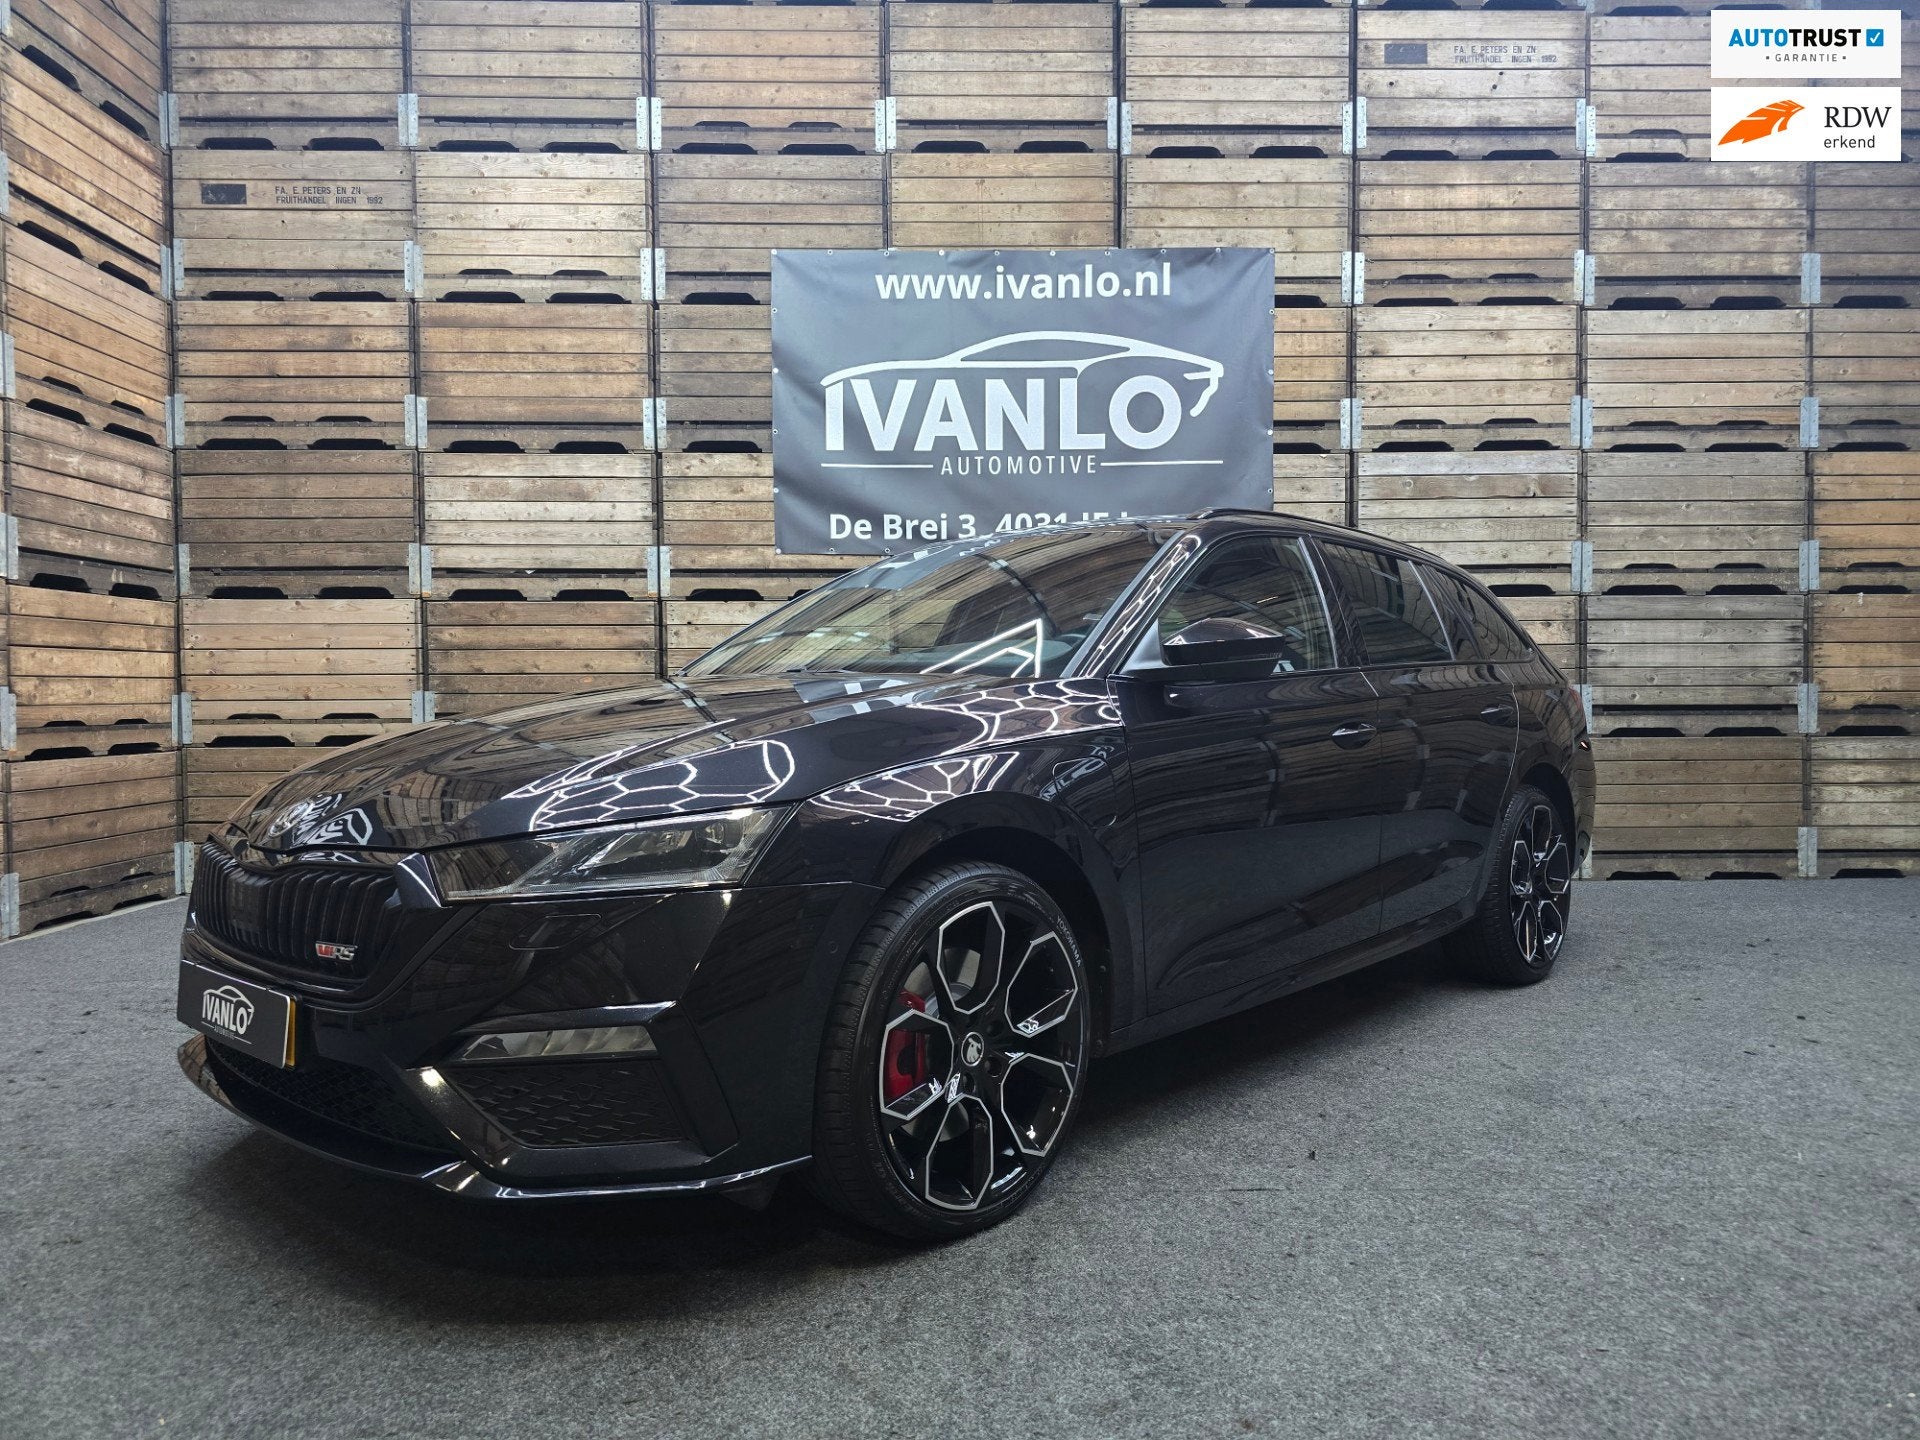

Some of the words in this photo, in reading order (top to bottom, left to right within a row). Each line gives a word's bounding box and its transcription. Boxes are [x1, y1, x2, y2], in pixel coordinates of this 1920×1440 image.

[1480, 45, 1508, 54] PETERS
[1512, 45, 1523, 54] EN
[1526, 45, 1537, 54] ZN
[1511, 55, 1532, 63] INGEN
[275, 196, 327, 205] FRUITHANDEL
[335, 196, 357, 205] INGEN
[302, 186, 332, 195] PETERS
[336, 186, 347, 195] EN
[351, 186, 361, 195] ZN
[875, 262, 1171, 300] www.ivanlo.nl
[825, 373, 1183, 452] IVANLO
[940, 455, 1097, 476] AUTOMOTIVE
[829, 513, 872, 540] De
[883, 513, 948, 540] Brei
[958, 513, 976, 539] 3
[202, 993, 248, 1035] IVANLO
